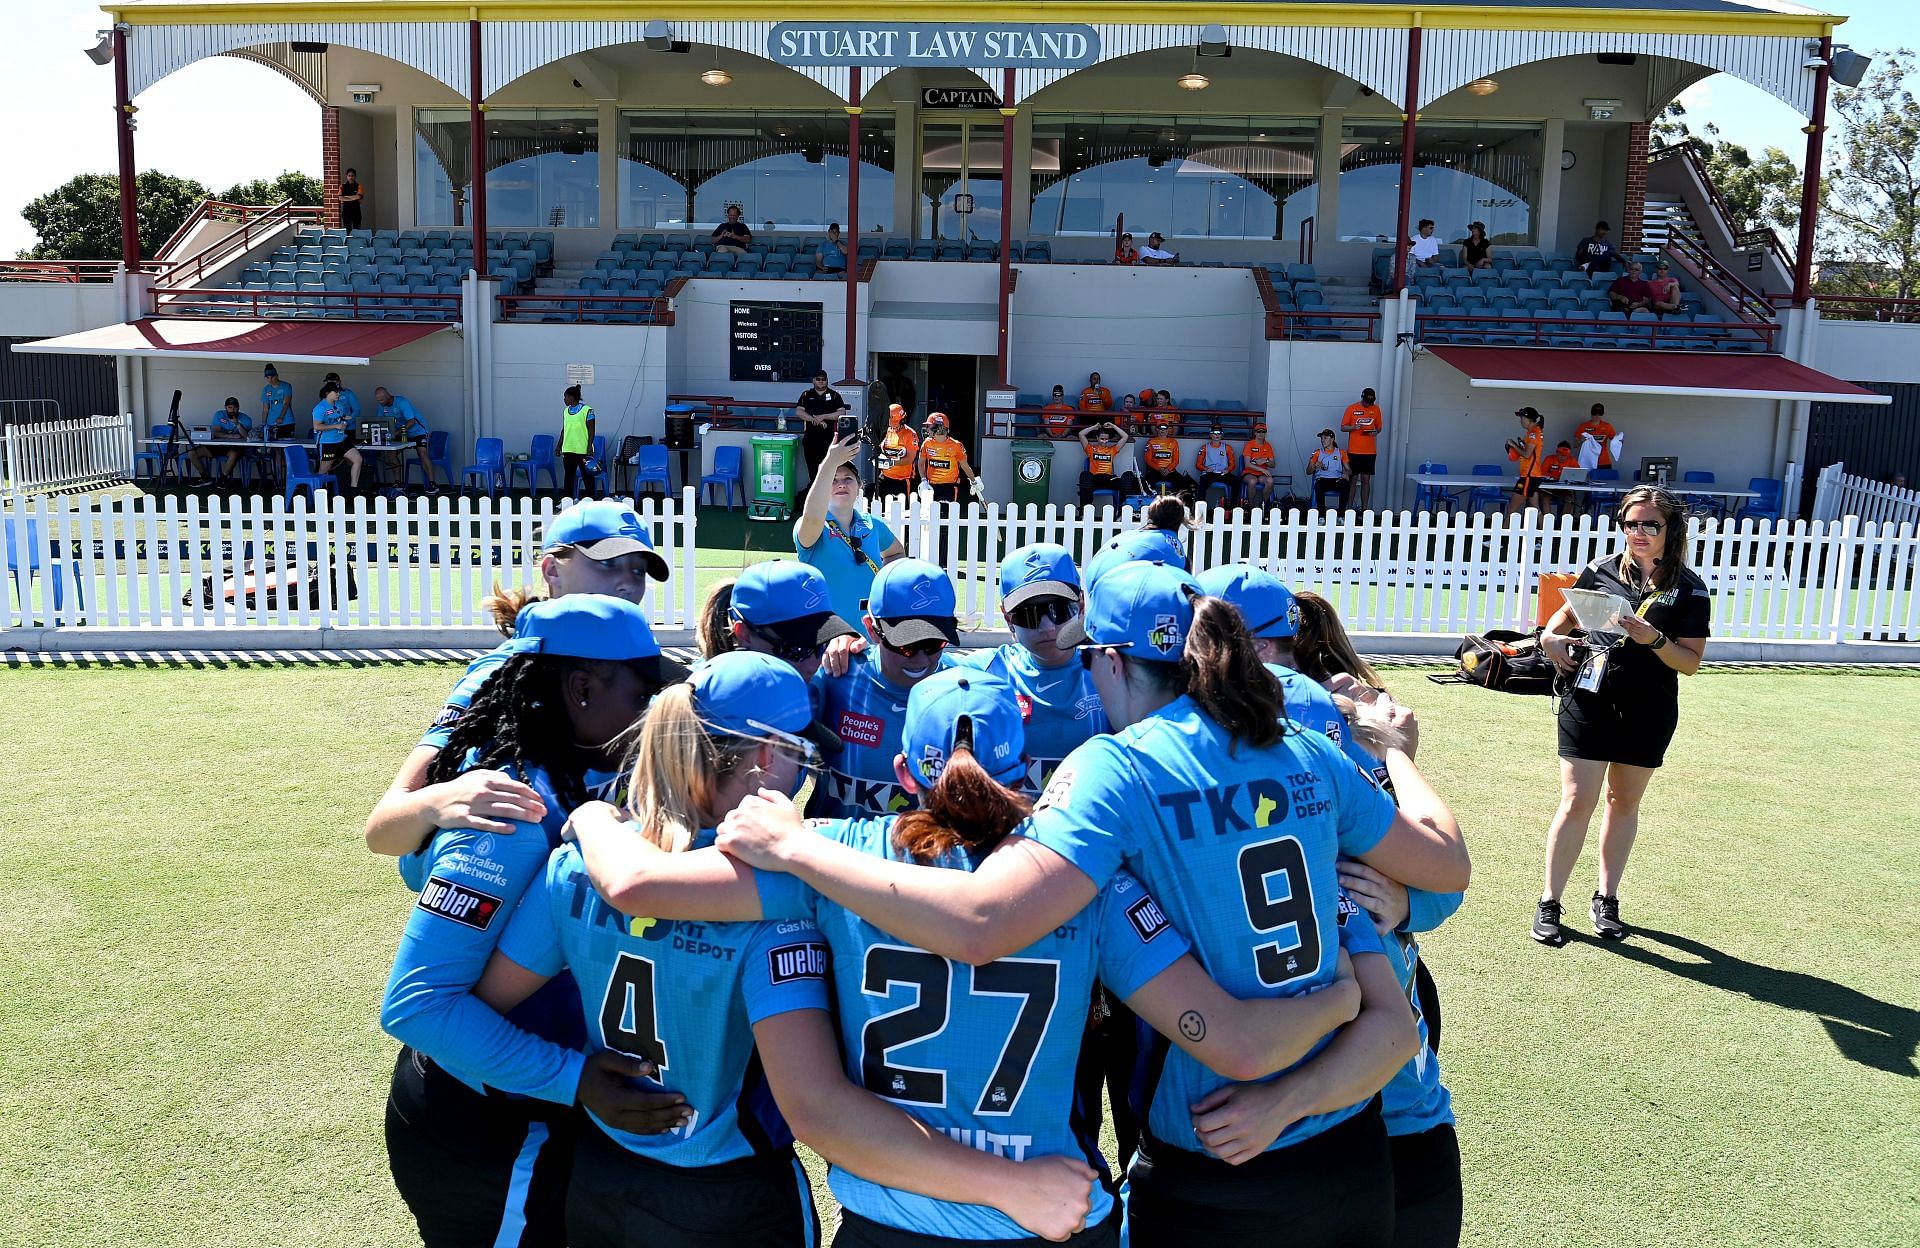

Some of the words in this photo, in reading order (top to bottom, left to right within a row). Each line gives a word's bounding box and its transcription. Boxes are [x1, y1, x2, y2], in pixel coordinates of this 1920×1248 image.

[780, 30, 898, 58] STUART
[907, 31, 976, 58] LAW
[983, 31, 1087, 60] STAND
[841, 726, 877, 742] Choice
[843, 715, 879, 731] People's
[993, 741, 1010, 759] 100
[1291, 787, 1315, 803] KIT
[1158, 778, 1290, 841] TKD
[452, 848, 505, 874] Australian
[456, 860, 508, 887] Networks
[421, 881, 479, 918] weber
[1236, 835, 1322, 989] 9
[674, 919, 706, 939] KIT
[777, 922, 800, 935] Gas
[672, 935, 736, 961] DEPOT
[776, 943, 828, 977] webe
[598, 950, 670, 1087] 4
[860, 943, 1061, 1116] 27
